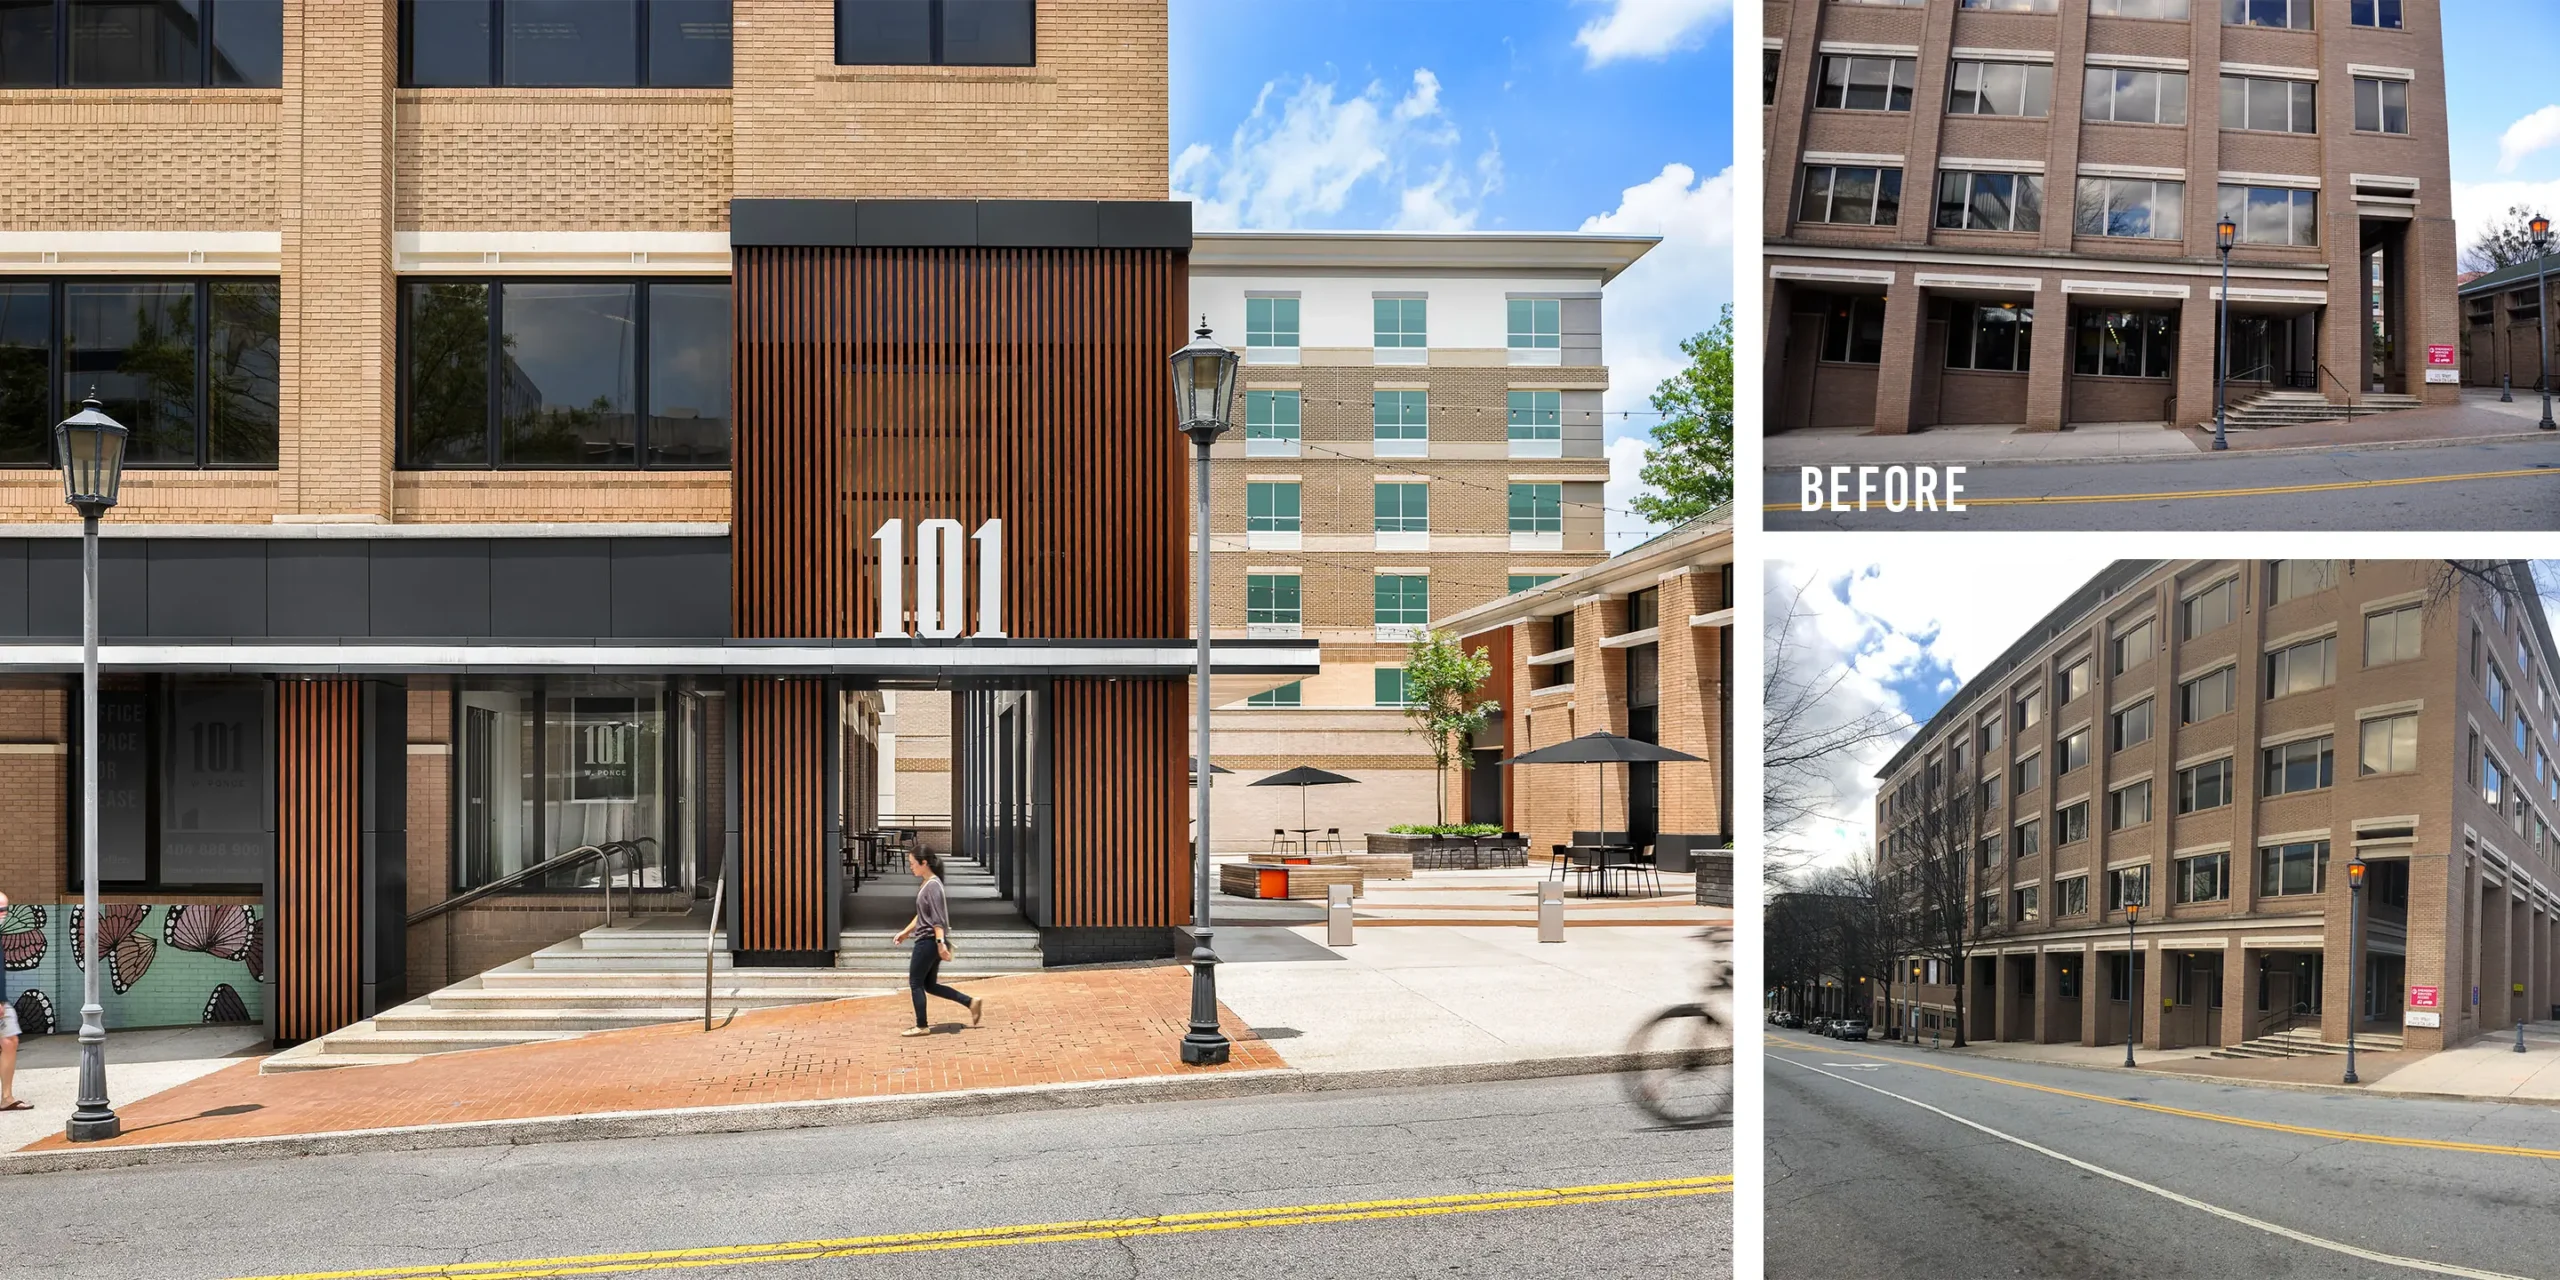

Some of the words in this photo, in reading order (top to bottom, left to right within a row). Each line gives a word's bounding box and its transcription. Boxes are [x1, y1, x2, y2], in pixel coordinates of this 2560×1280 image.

[870, 518, 1007, 639] 101
[99, 703, 143, 722] FFICE
[99, 732, 138, 751] PACE
[188, 721, 245, 773] 101
[584, 725, 627, 765] 101
[99, 790, 138, 809] EASE
